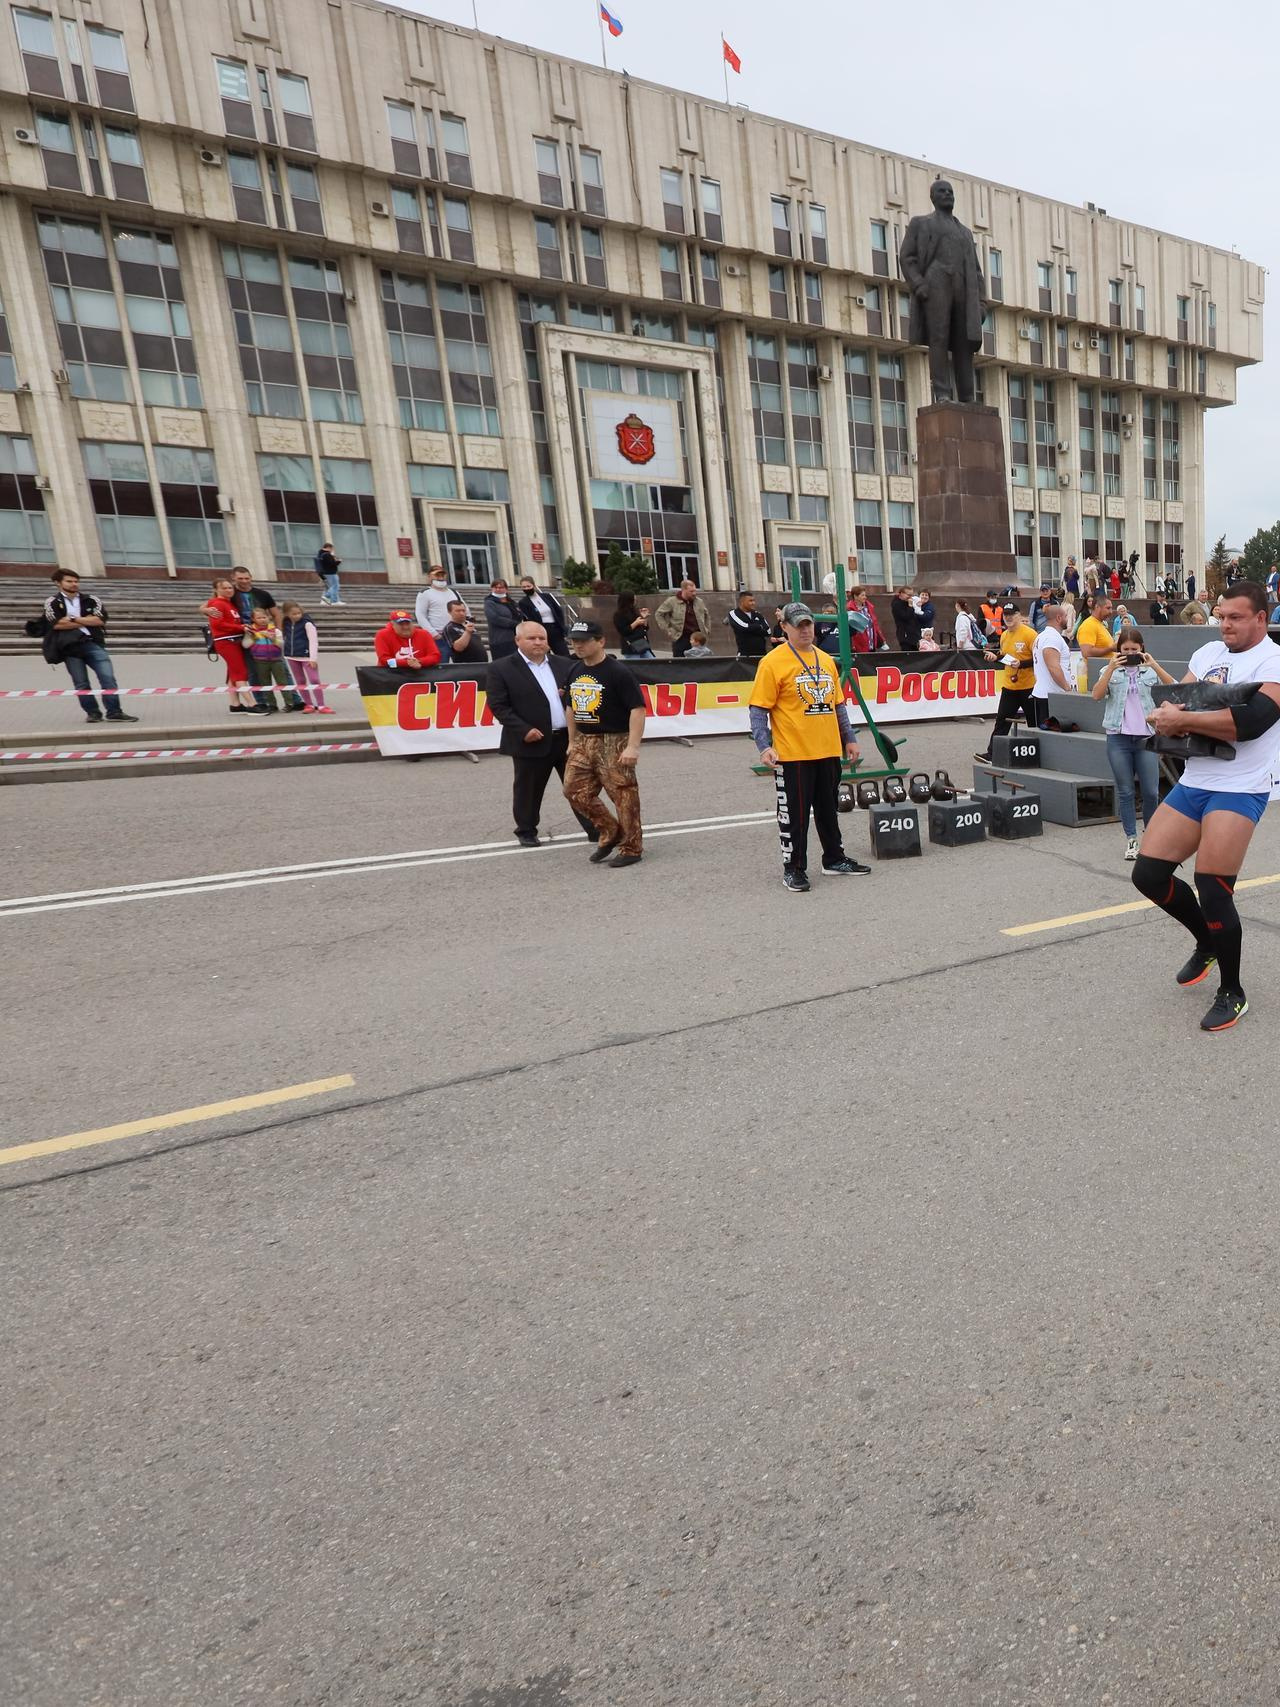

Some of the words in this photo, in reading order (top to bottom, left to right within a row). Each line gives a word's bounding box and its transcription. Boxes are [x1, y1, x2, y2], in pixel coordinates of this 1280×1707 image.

[1012, 745, 1036, 757] 180
[866, 791, 877, 799] 24
[893, 785, 904, 795] 32
[919, 785, 930, 793] 32
[1012, 803, 1039, 818] 220
[878, 818, 914, 833] 240
[956, 812, 982, 828] 200
